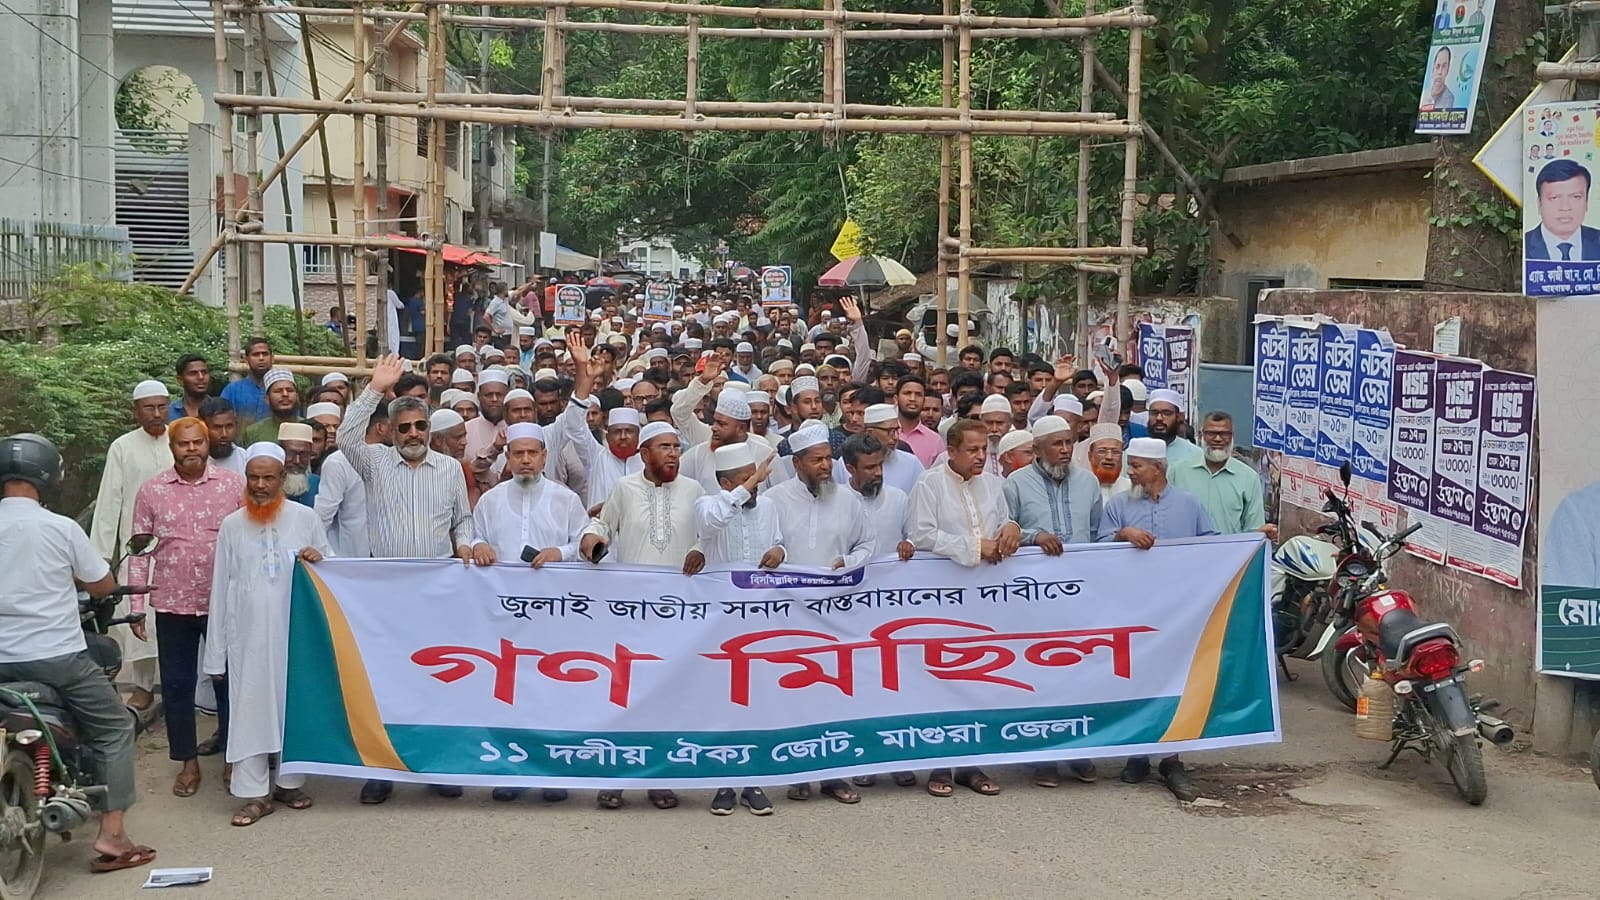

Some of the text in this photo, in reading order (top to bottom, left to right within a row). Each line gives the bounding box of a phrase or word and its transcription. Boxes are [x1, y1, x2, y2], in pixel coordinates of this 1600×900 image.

[1261, 329, 1287, 359] নটর
[1291, 332, 1318, 362] নটর
[1325, 336, 1354, 370] নটর
[1261, 358, 1285, 383] ডেম
[1360, 343, 1393, 378] নটর
[1291, 364, 1317, 388] ডেম
[1325, 370, 1351, 395] ডেম
[1402, 372, 1428, 395] HSC
[1360, 378, 1389, 406] ডেম
[1446, 380, 1474, 405] HSC
[1492, 392, 1523, 418] HSC
[497, 577, 1085, 622] জুলাই জাতীয় সনদ বাস্তবায়নের দাবীতে
[410, 617, 1159, 708] গণ মিছিল
[479, 716, 1094, 766] ১১ দলীয় ঐক্য জোট, মাগুরা জেলা
